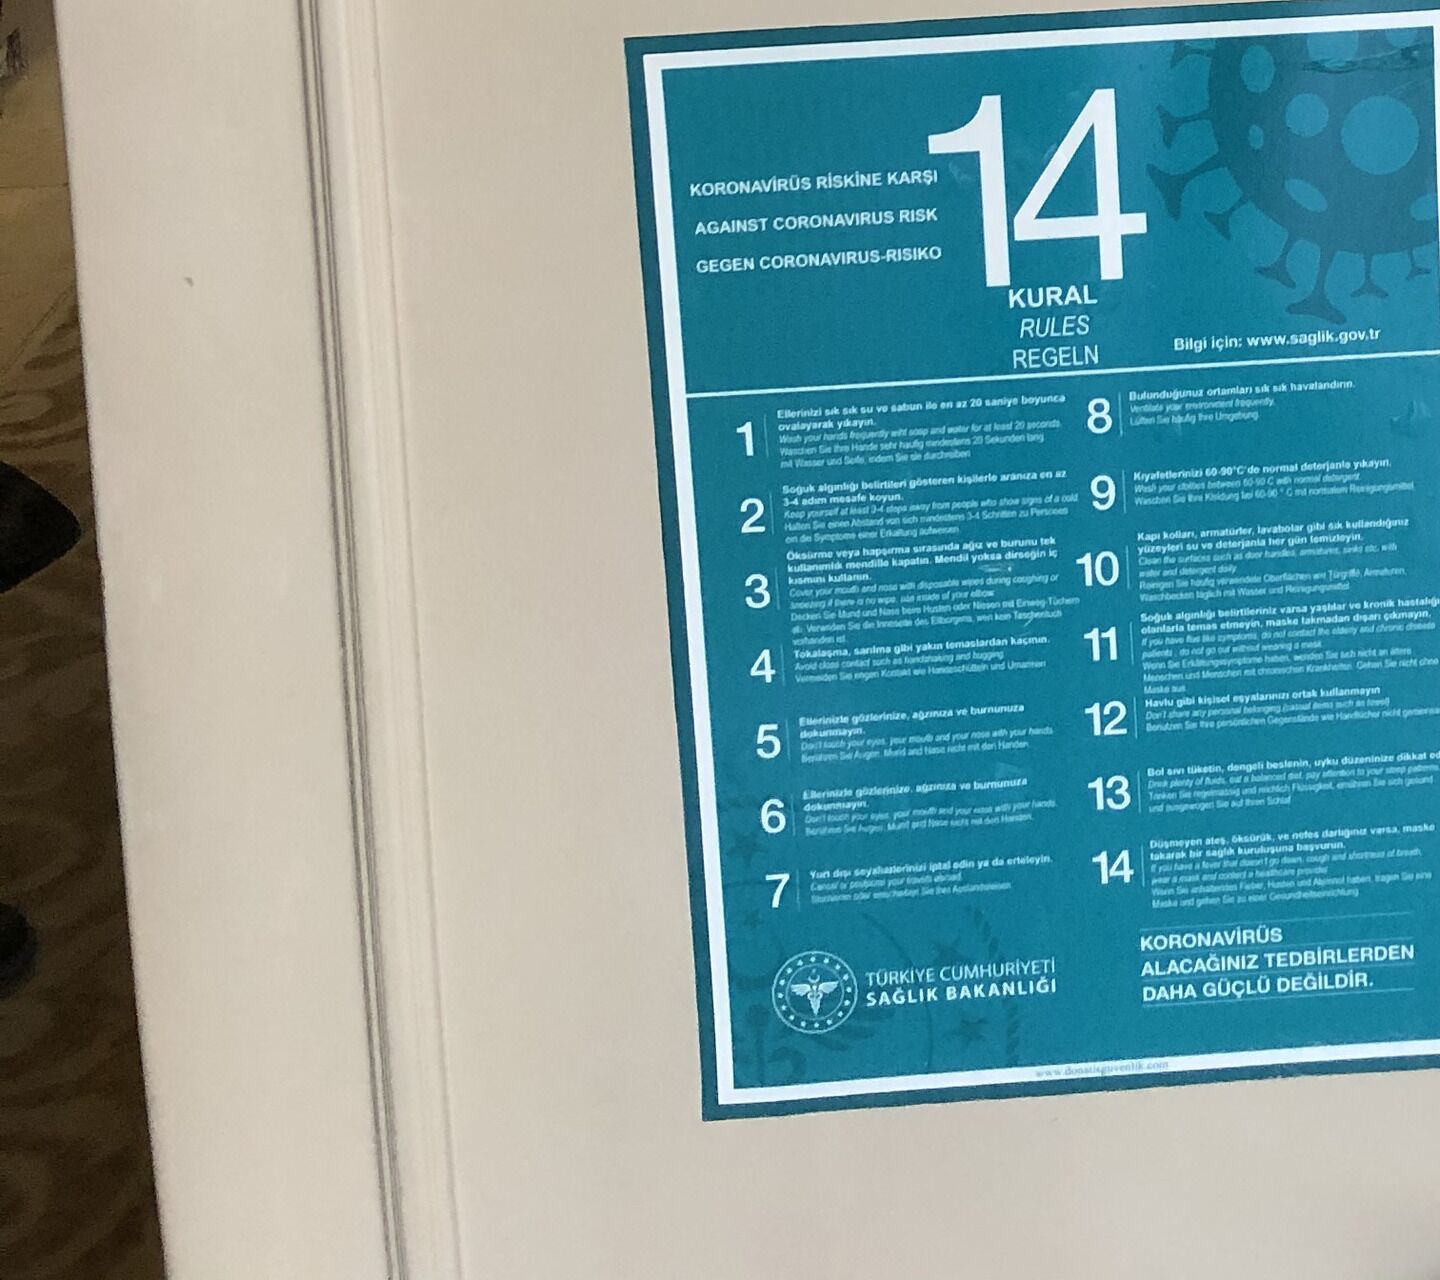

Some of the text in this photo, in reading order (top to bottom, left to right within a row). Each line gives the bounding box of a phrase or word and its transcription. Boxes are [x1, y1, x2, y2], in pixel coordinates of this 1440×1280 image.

[690, 169, 938, 197] KORONAVİRÜS RİSKİNE KARŞI
[927, 87, 1147, 288] 14
[694, 208, 938, 236] AGAINST CORONAVIRUS RISK
[696, 246, 943, 274] GEGEN CORONAVIRUS-RISIKO
[1008, 284, 1098, 309] KURAL
[1019, 314, 1090, 339] RULES
[1174, 327, 1382, 353] Bilgi için: www.saglik.gov.tr
[1012, 344, 1099, 369] REGELN
[970, 397, 982, 408] 20
[1086, 397, 1113, 434] 8
[736, 421, 754, 457] 1
[1089, 474, 1116, 511] 9
[740, 497, 766, 534] 2
[1075, 550, 1120, 587] 10
[744, 573, 771, 609] 3
[1083, 626, 1118, 662] 11
[750, 648, 776, 684] 4
[1084, 699, 1128, 737] 12
[756, 723, 782, 759] 5
[1087, 774, 1131, 811] 13
[760, 798, 787, 834] 6
[1091, 848, 1135, 885] 14
[765, 872, 791, 909] 7
[1140, 924, 1283, 952] KORONAVİRÜS
[865, 956, 1056, 988] TÜRKİYE CUMHURİYETİ
[1141, 944, 1415, 977] ALACAĞINIZ TEDBİRLERDEN
[866, 976, 1057, 1007] SAĞLIK BAKANLIĞI
[1142, 969, 1374, 1002] DAHA GÜÇLÜ DEĞİLDİR.
